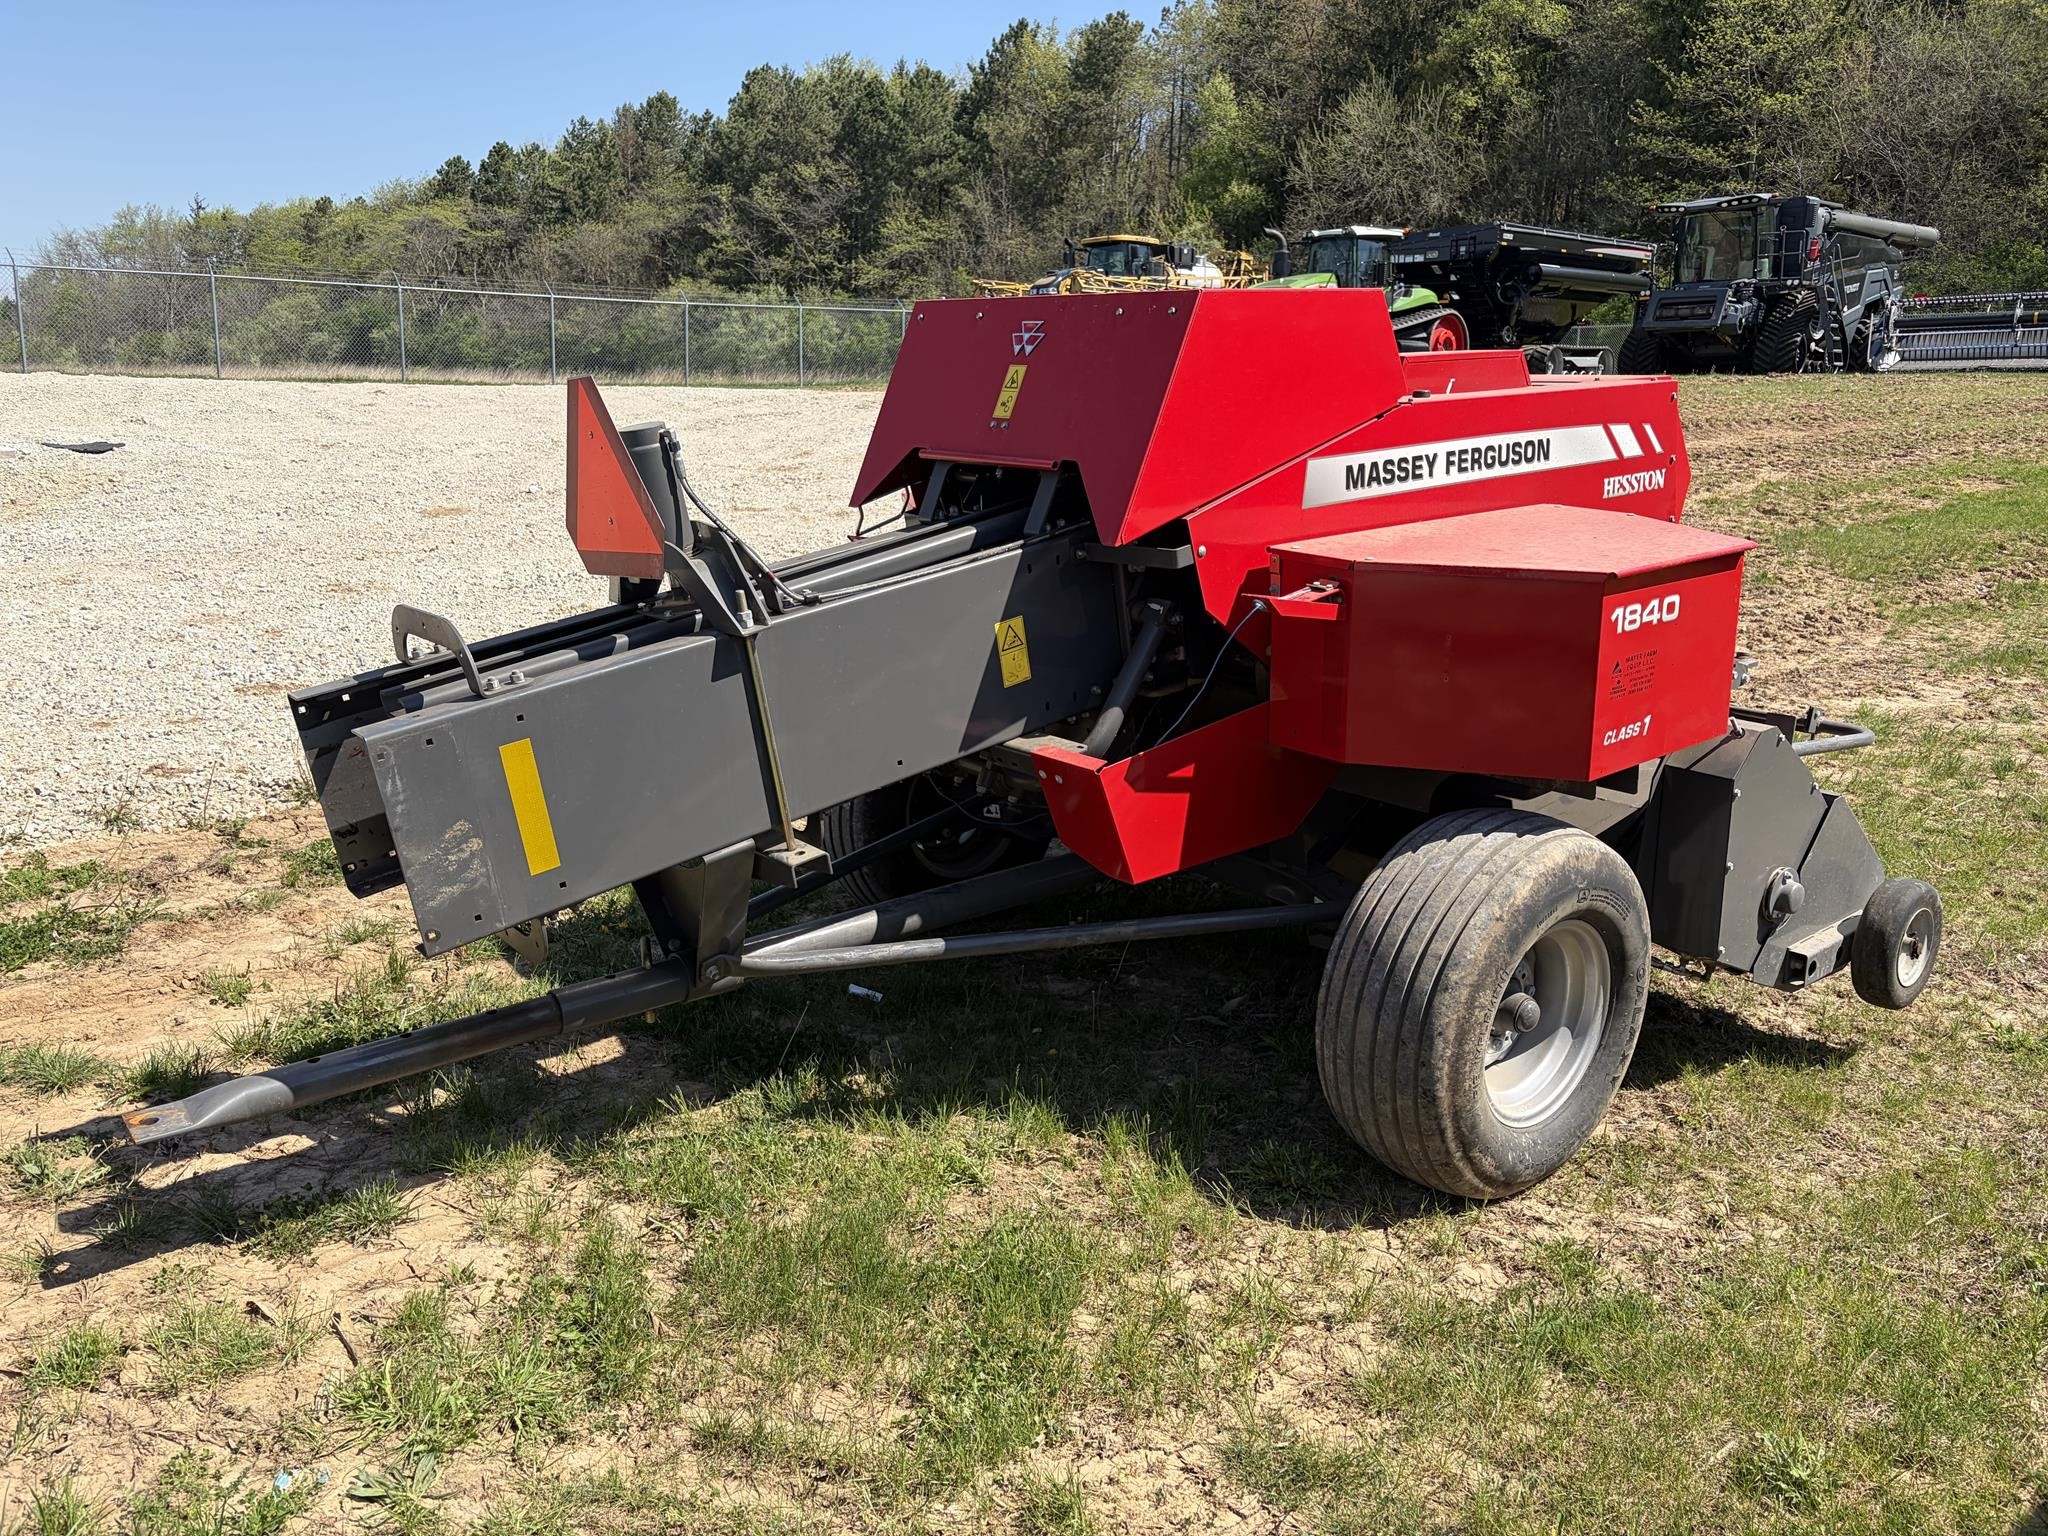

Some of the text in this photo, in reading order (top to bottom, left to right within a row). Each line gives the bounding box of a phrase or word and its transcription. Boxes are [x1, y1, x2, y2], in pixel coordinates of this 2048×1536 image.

[1344, 438, 1552, 491] MASSEY FERGUSON
[1602, 468, 1667, 499] HESSTON
[1610, 593, 1681, 634] 1840
[1603, 714, 1652, 746] CLASS 1
